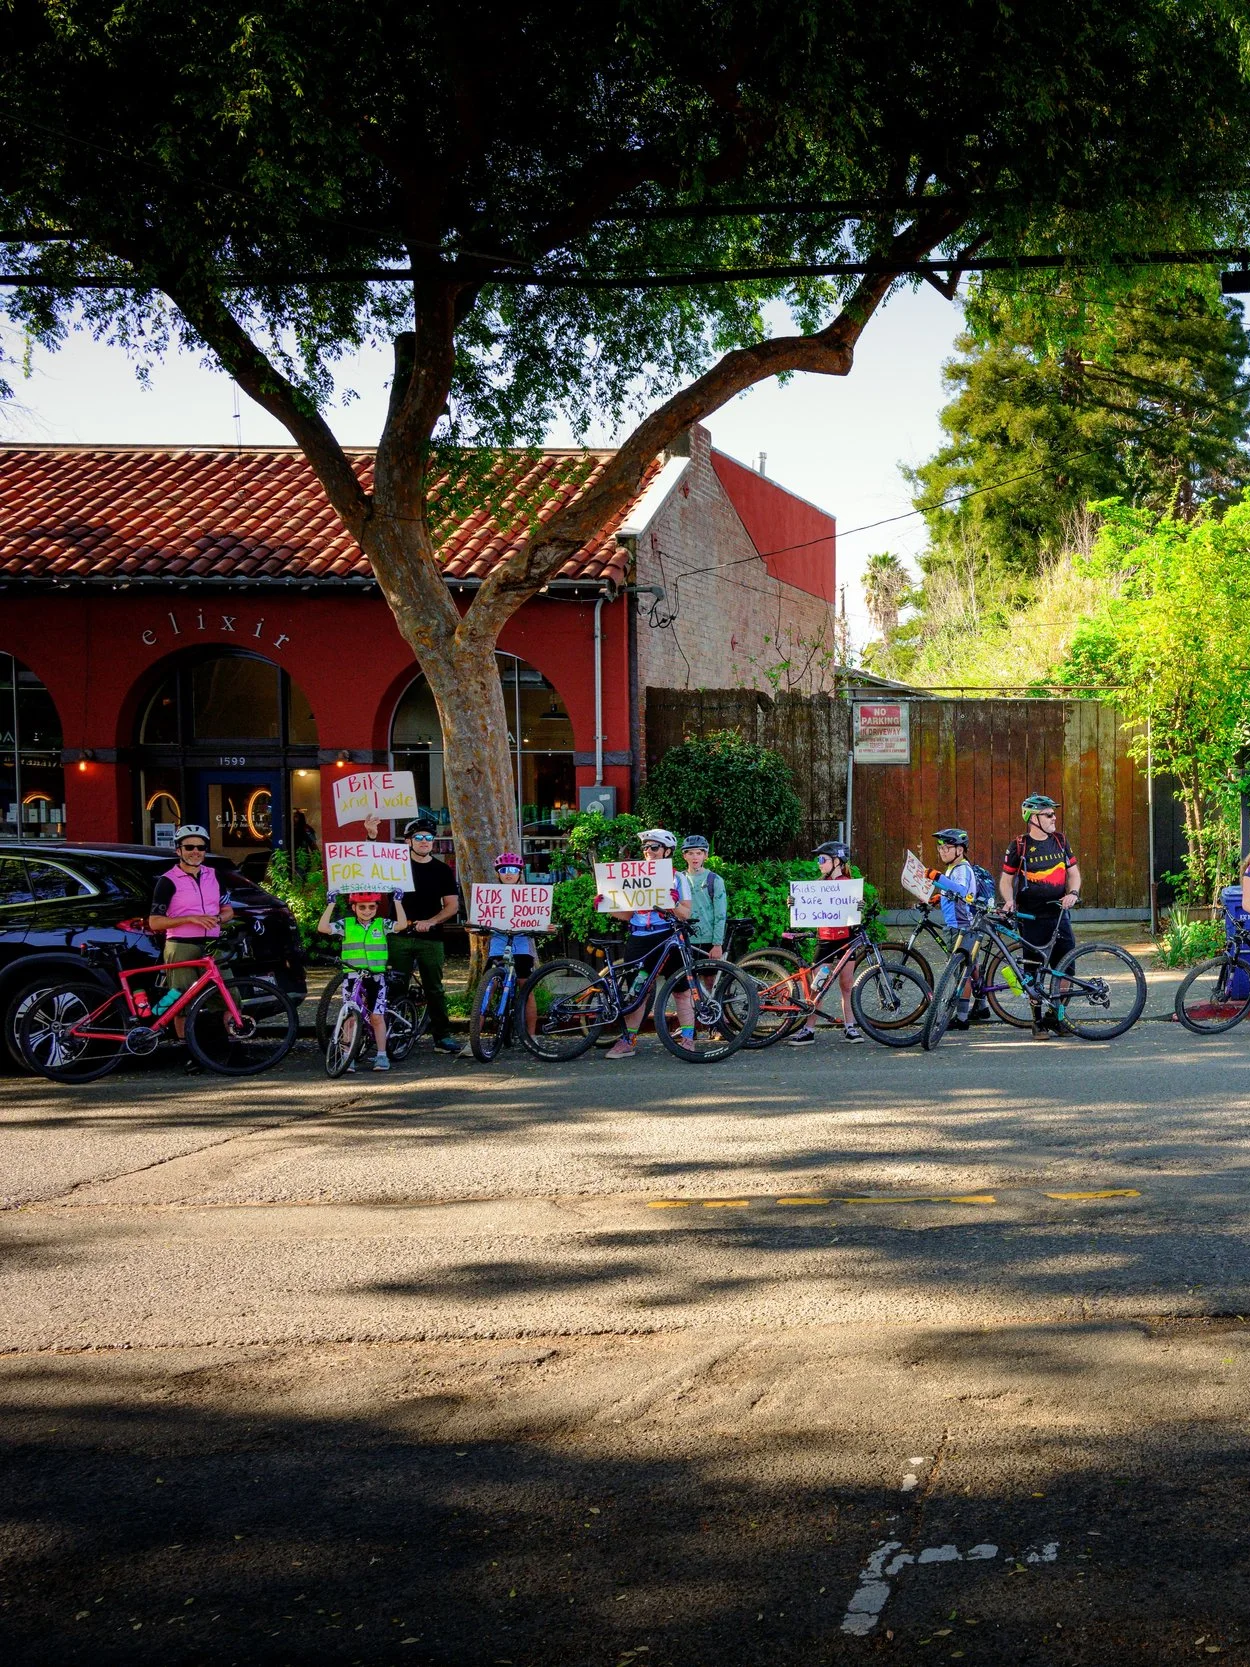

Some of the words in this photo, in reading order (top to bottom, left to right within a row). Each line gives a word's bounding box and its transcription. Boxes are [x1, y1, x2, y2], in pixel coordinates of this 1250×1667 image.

[142, 608, 290, 649] elixir
[873, 708, 887, 716] NO
[861, 717, 900, 725] PARKING
[868, 728, 901, 736] DRIVEWAY
[220, 757, 246, 766] 1599
[374, 791, 379, 809] I
[383, 791, 415, 808] vote
[216, 811, 265, 822] elixir
[328, 844, 368, 859] BIKE
[372, 844, 409, 861] LANES
[331, 862, 365, 882] FOR
[370, 862, 408, 881] ALL!
[605, 863, 617, 880] I
[621, 861, 657, 878] BIKE
[622, 877, 652, 890] AND
[791, 883, 816, 893] Kids
[820, 883, 841, 892] need
[475, 886, 502, 905] KIDS
[511, 887, 549, 903] NEED
[608, 890, 620, 909] I
[623, 888, 666, 908] VOTE
[801, 895, 823, 905] safe
[477, 904, 507, 919] SAFE
[513, 905, 551, 918] ROUTES
[794, 908, 807, 921] to
[812, 910, 841, 920] school
[509, 917, 541, 929] SCHOOL
